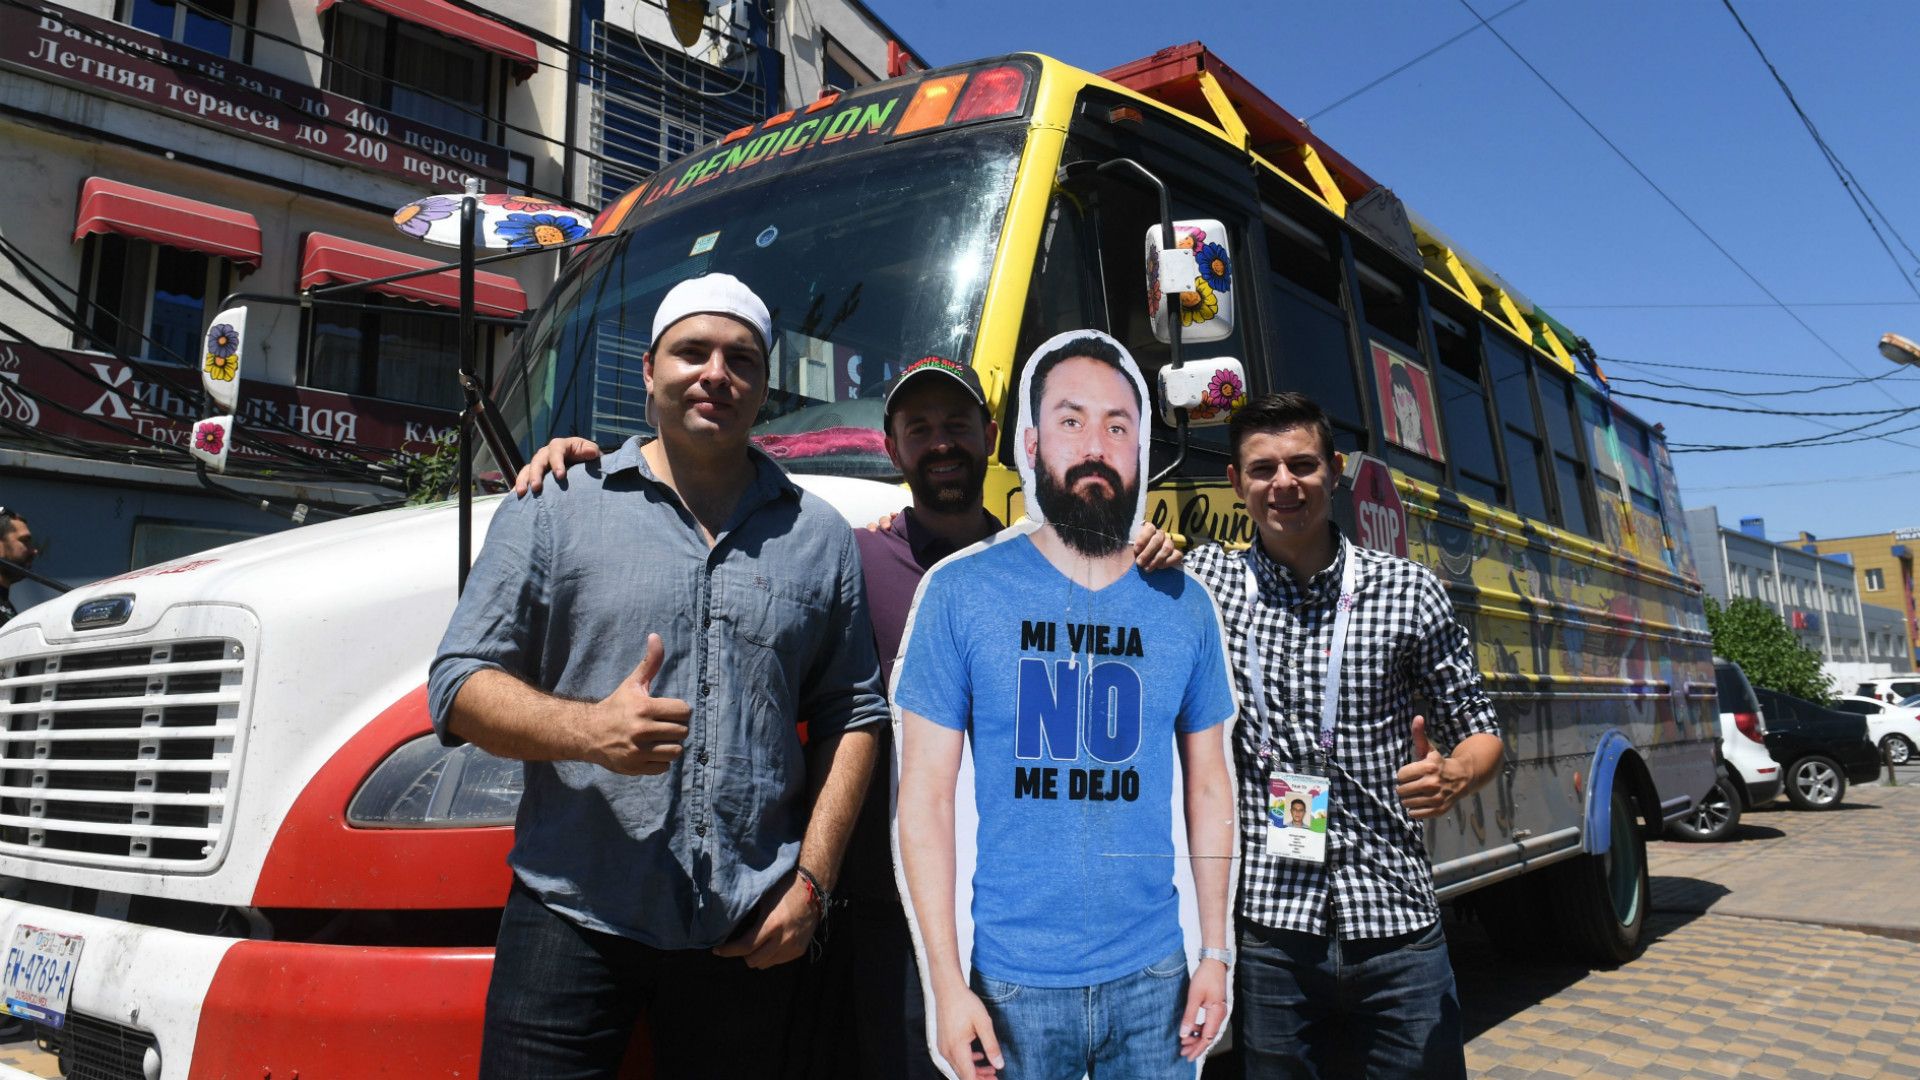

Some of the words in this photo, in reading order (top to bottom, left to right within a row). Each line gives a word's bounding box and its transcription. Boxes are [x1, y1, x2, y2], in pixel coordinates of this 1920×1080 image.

[28, 38, 155, 93] Летняя
[166, 82, 280, 131] терасса
[295, 124, 328, 145] до
[343, 133, 388, 163] 200
[345, 107, 390, 136] 400
[404, 130, 488, 168] персон
[643, 177, 676, 207] LA
[1359, 500, 1400, 556] STOP
[1020, 620, 1056, 652] MI
[1066, 622, 1144, 657] VIEJA
[1015, 657, 1143, 764] NO
[1014, 766, 1058, 799] ME
[1068, 765, 1140, 802] DEJÓ
